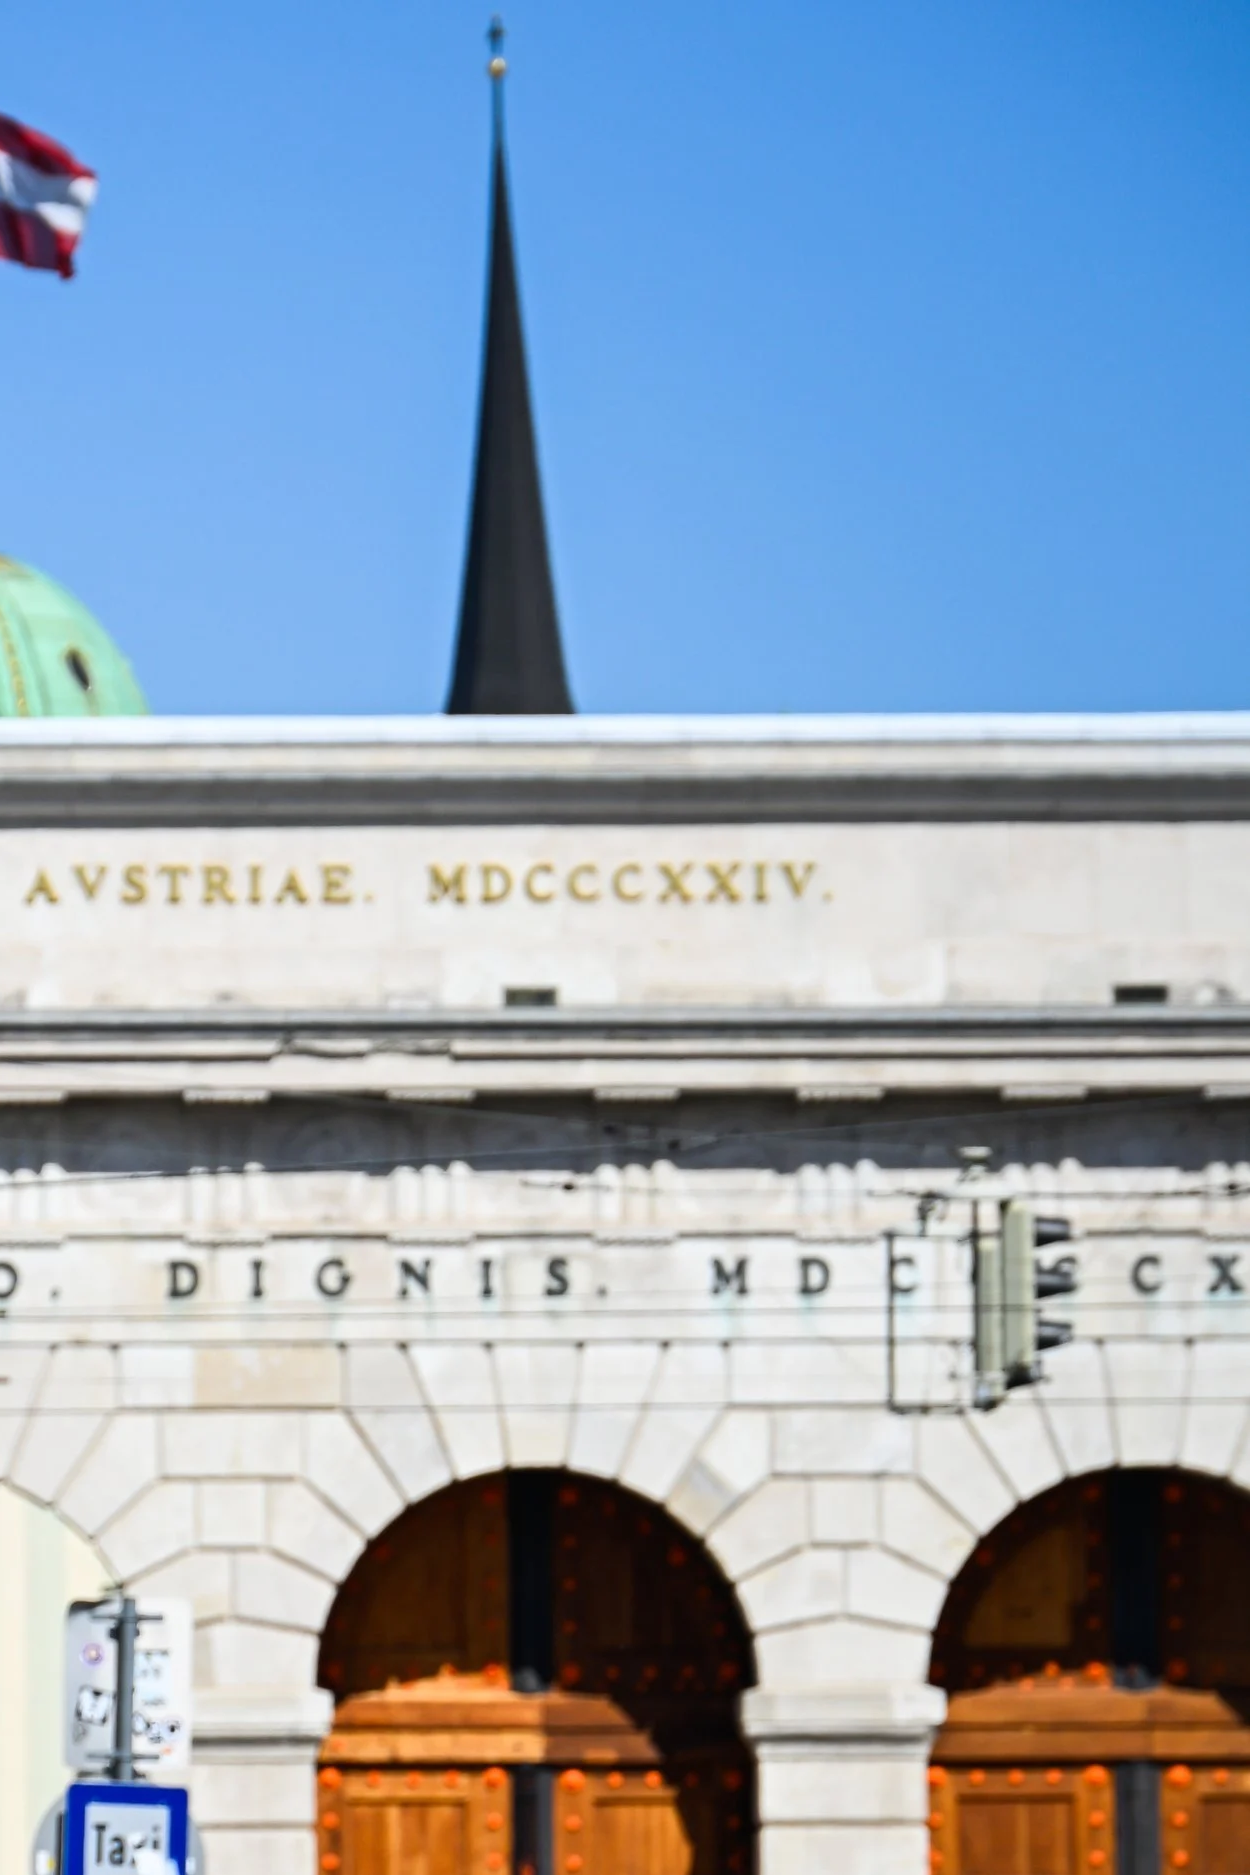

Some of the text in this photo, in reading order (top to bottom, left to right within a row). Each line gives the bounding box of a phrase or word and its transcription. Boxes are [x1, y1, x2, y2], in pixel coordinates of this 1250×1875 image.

[25, 864, 374, 905] AVSTRIAE.
[428, 862, 833, 904] MDCCCXXIV.
[167, 1257, 608, 1301] DIGNIS.
[710, 1254, 1246, 1299] MDCCX
